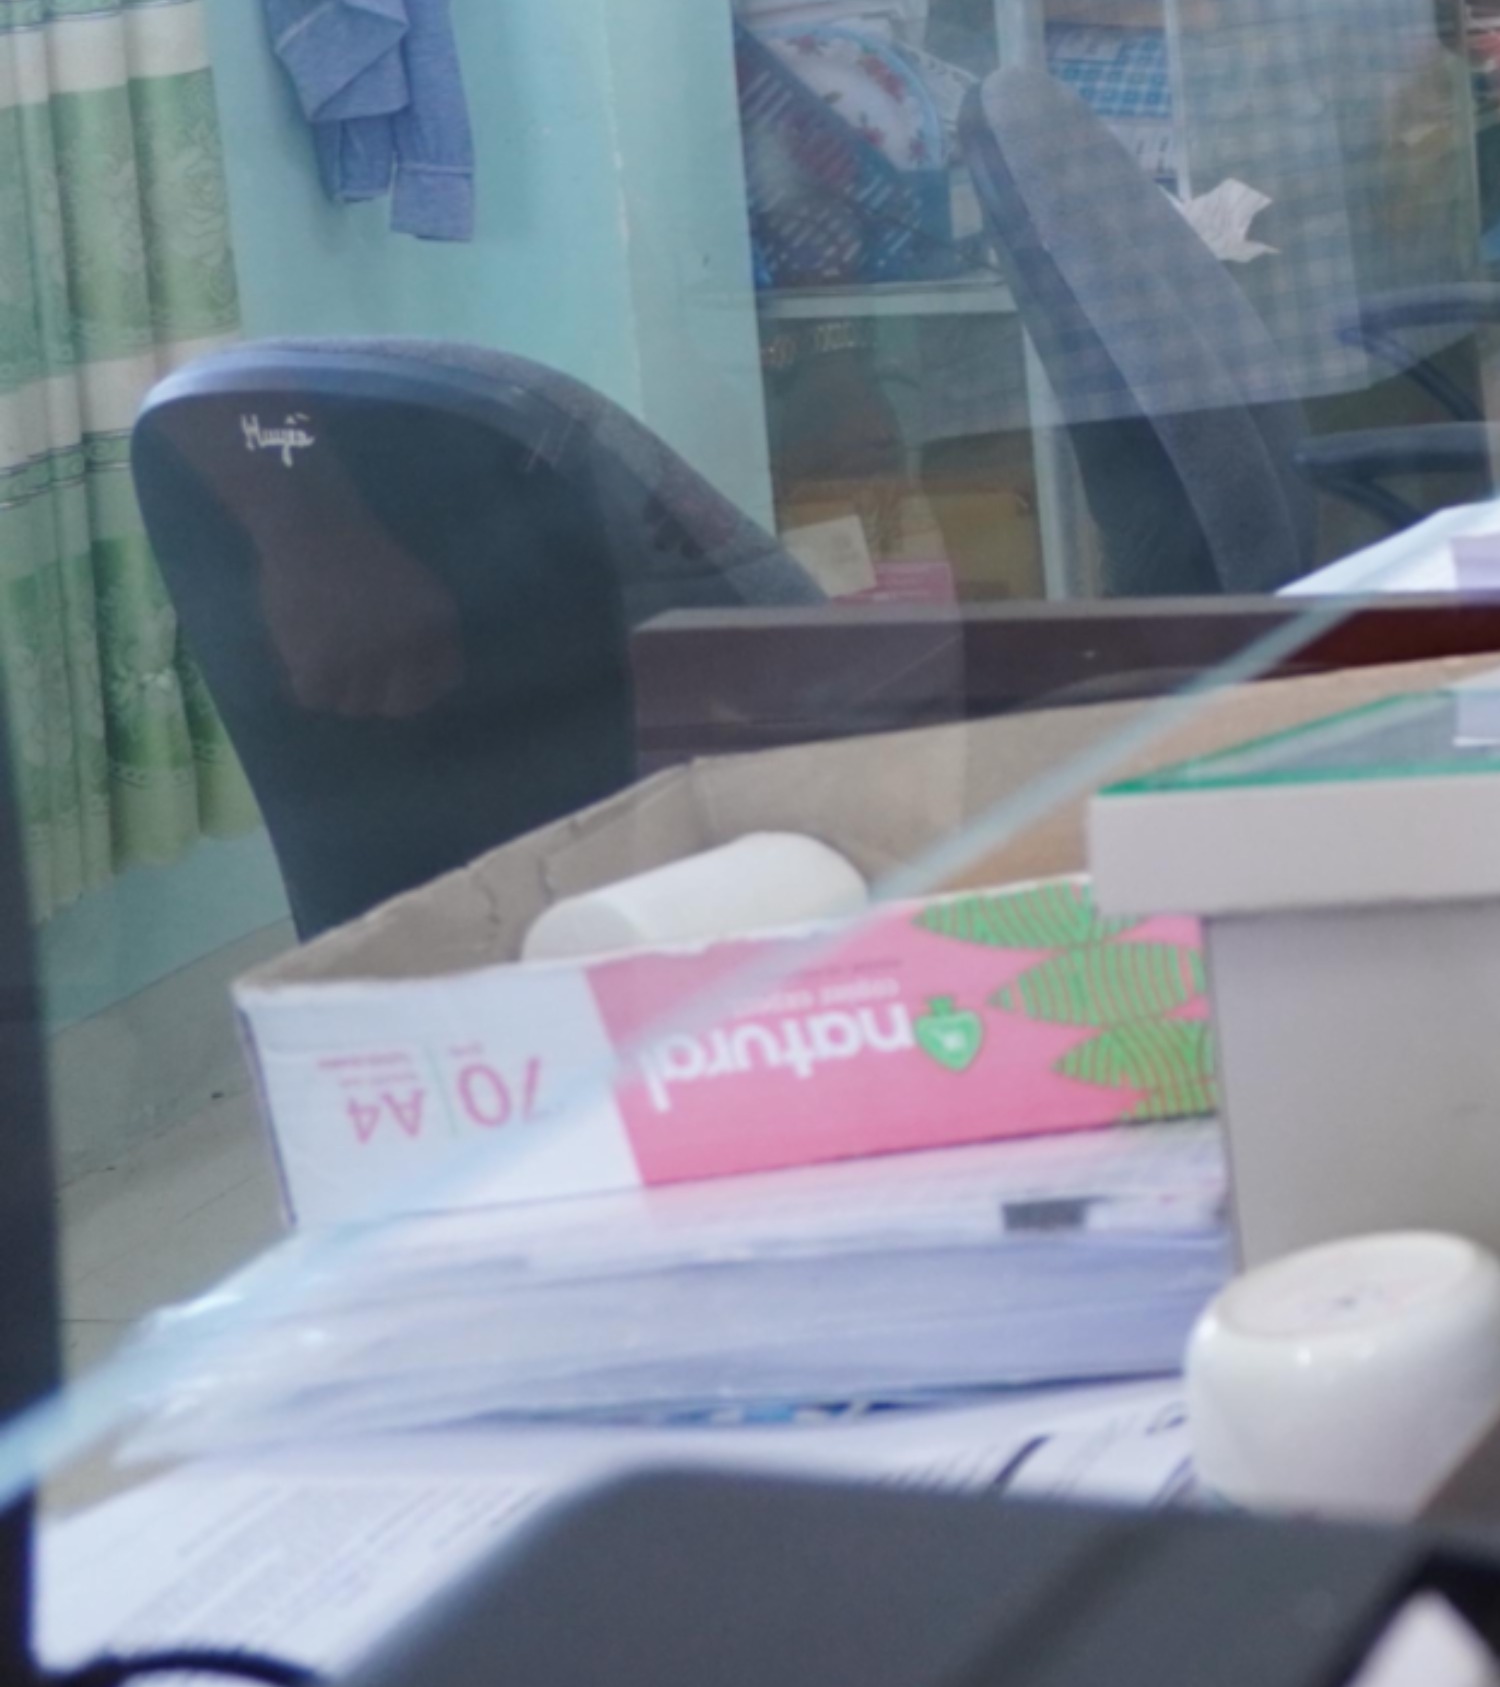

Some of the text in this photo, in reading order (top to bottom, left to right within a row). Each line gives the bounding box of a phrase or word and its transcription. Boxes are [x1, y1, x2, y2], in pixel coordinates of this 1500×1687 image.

[456, 1056, 541, 1128] 70
[640, 1001, 917, 1111] natural
[346, 1086, 425, 1144] A4
